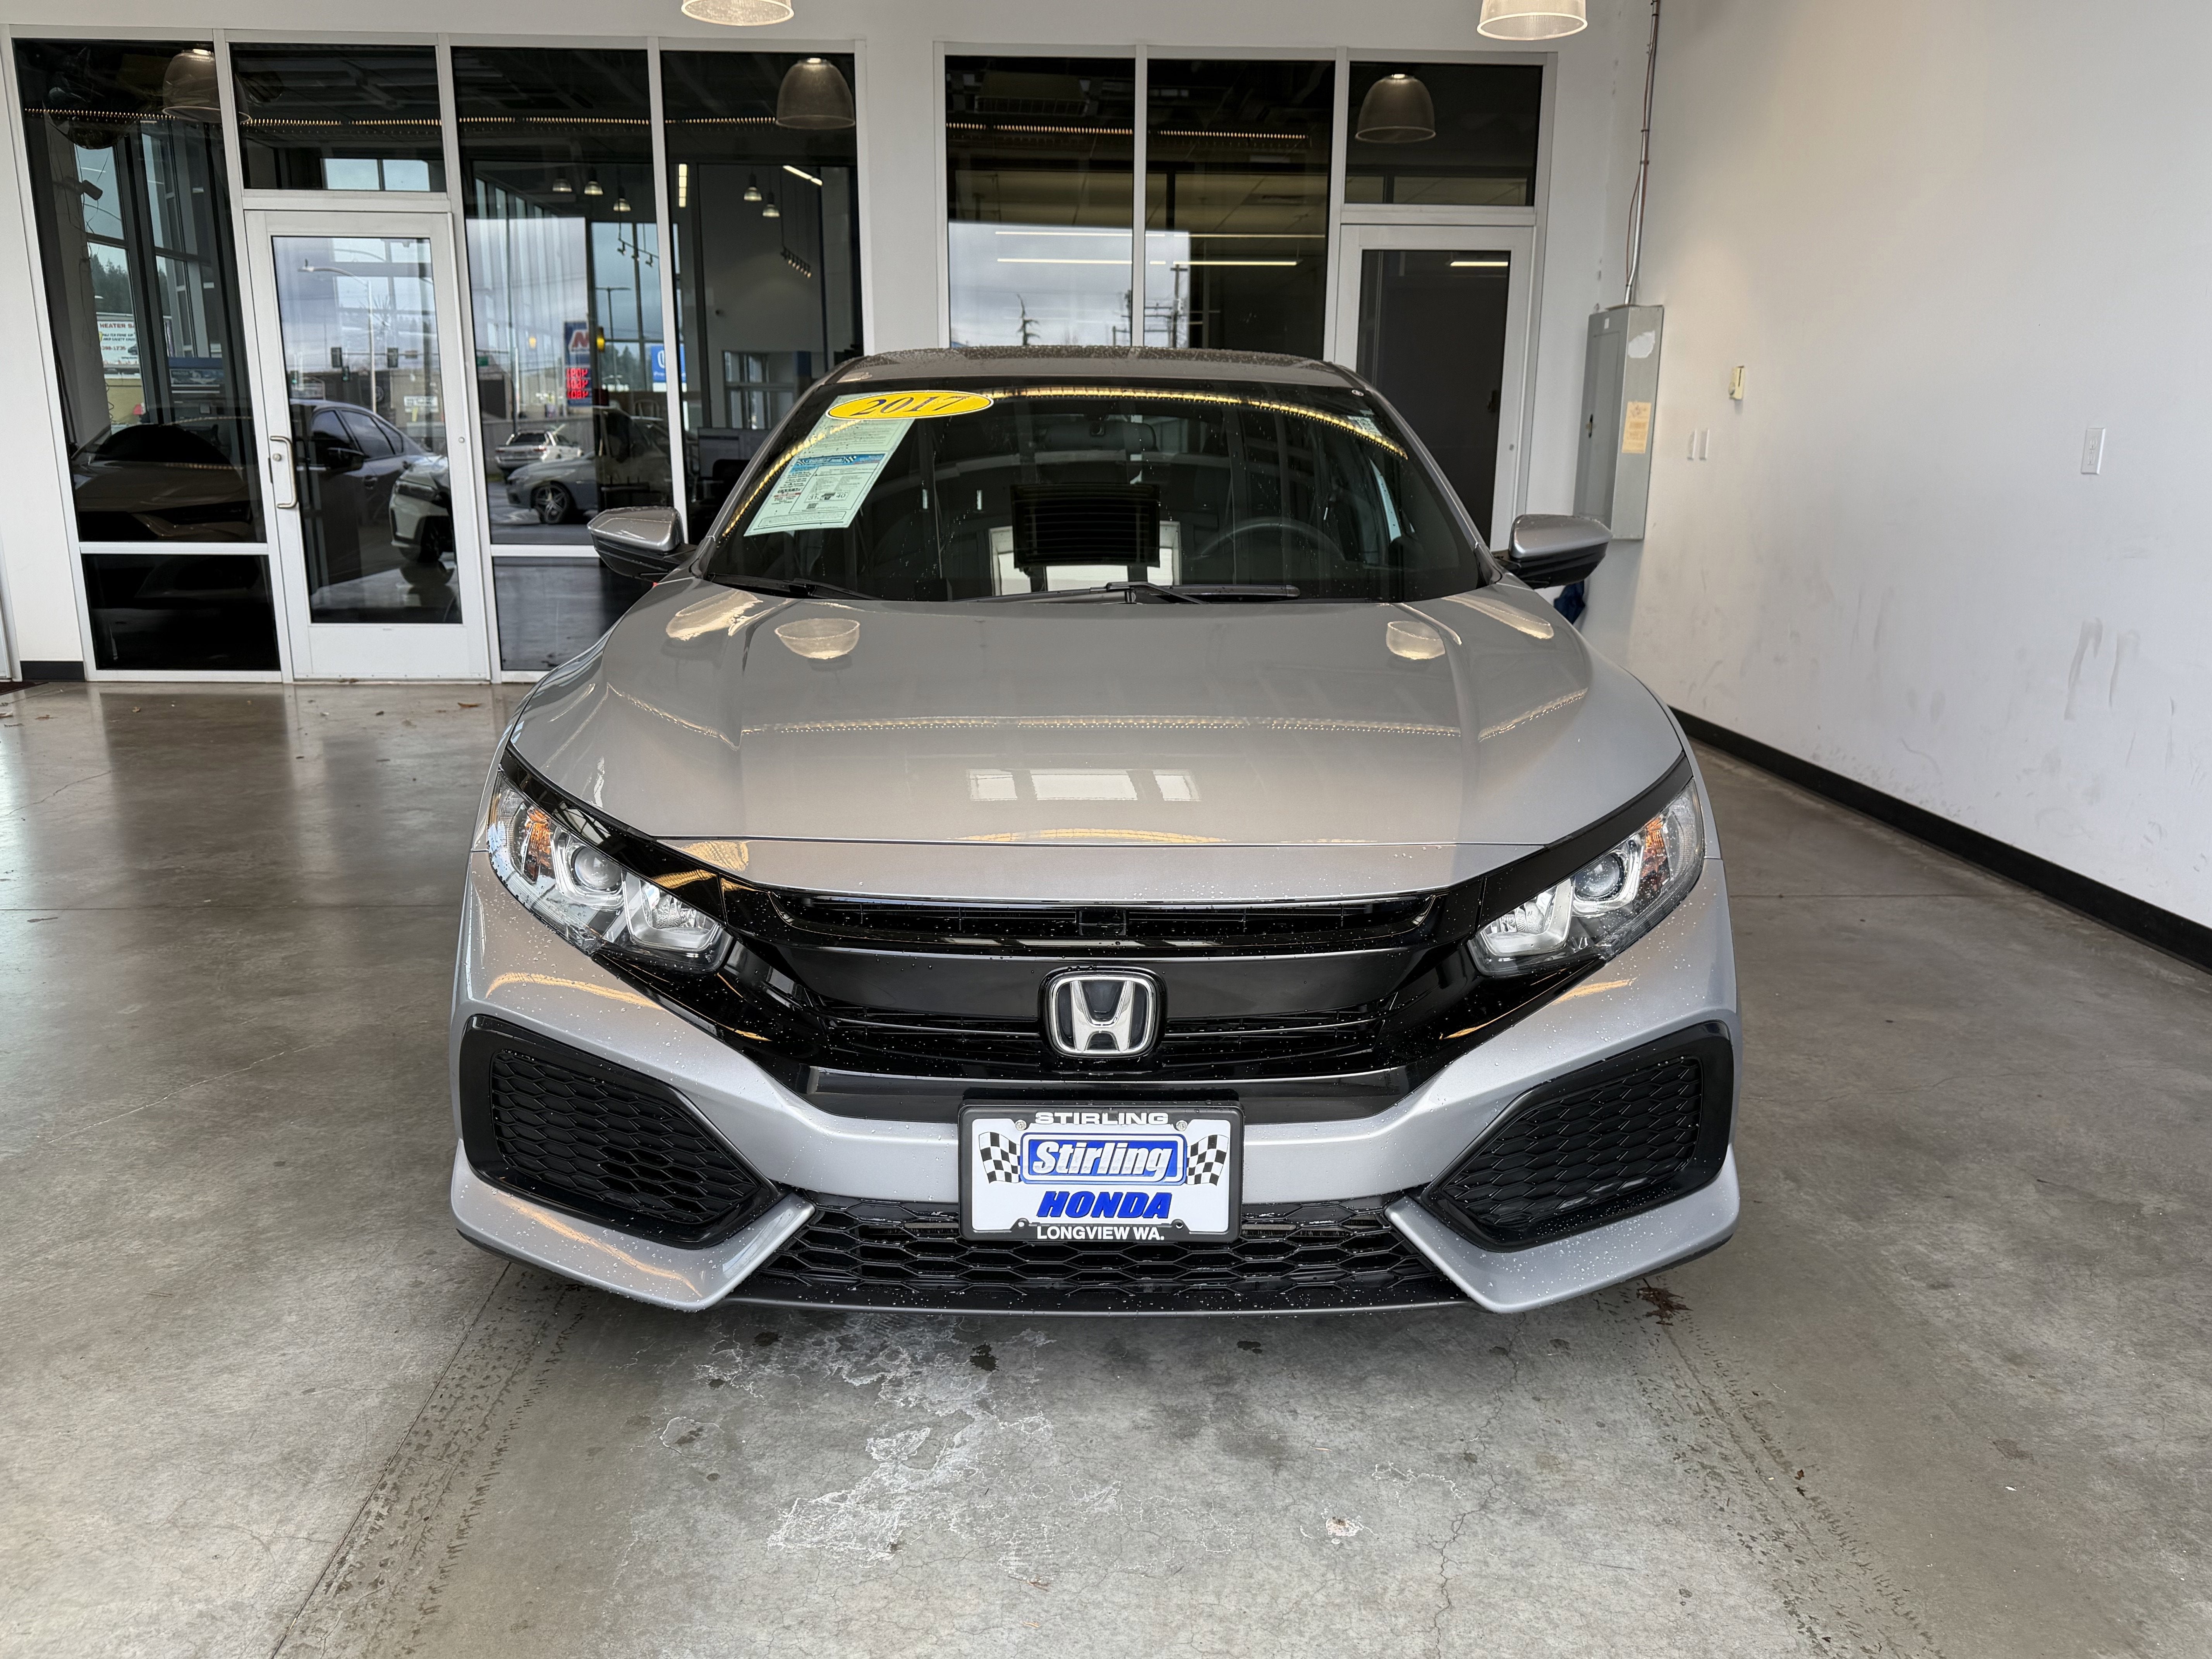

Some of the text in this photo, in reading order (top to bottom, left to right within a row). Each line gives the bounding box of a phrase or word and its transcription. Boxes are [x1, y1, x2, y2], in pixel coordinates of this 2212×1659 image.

[849, 396, 971, 416] 2017
[1035, 1112, 1169, 1125] STIRLING
[1032, 1141, 1173, 1179] Stirling
[1036, 1190, 1172, 1219] HONDA
[1037, 1226, 1165, 1240] LONGVIEW WA.
